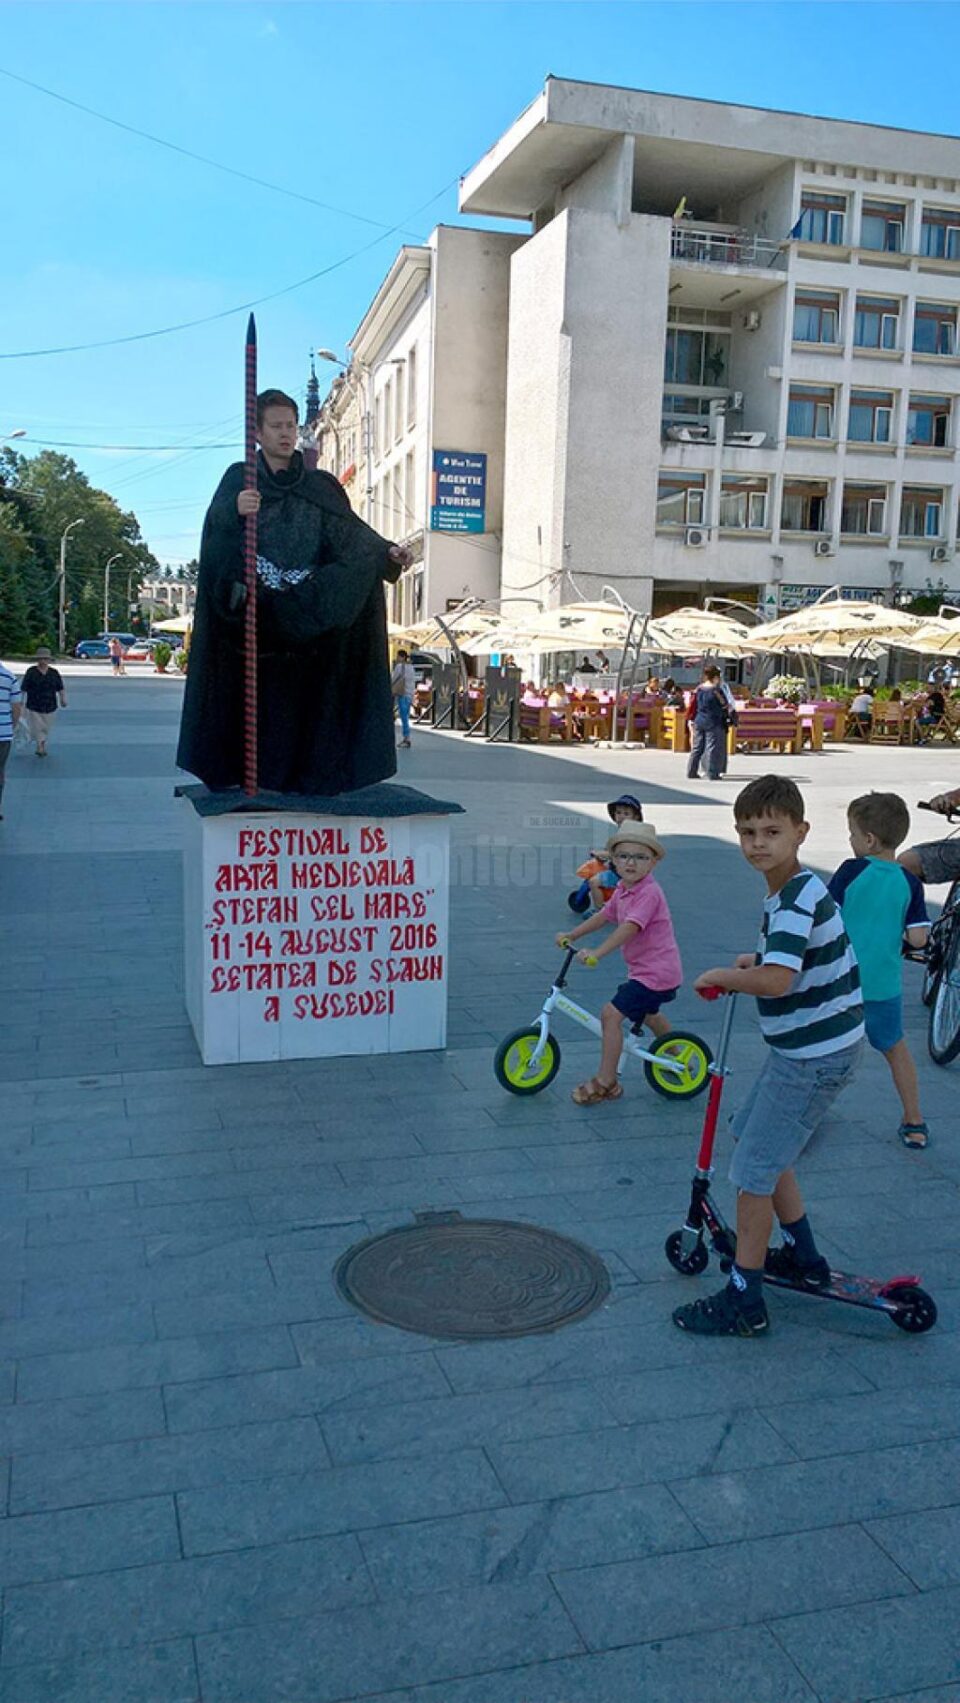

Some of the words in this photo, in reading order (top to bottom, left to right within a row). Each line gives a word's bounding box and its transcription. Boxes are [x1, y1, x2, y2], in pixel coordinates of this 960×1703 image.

[439, 496, 481, 507] TURISM
[453, 486, 467, 495] DE
[238, 828, 350, 858] FESTIVAL
[360, 826, 389, 855] DE
[310, 895, 355, 921] CEL
[280, 926, 379, 956] AUGUST
[390, 923, 438, 951] 2016
[211, 961, 317, 993] CETATEA
[328, 959, 357, 986] DE
[368, 955, 443, 983] SCAUN
[264, 996, 280, 1022] A
[292, 989, 394, 1020] SUCEVEI
